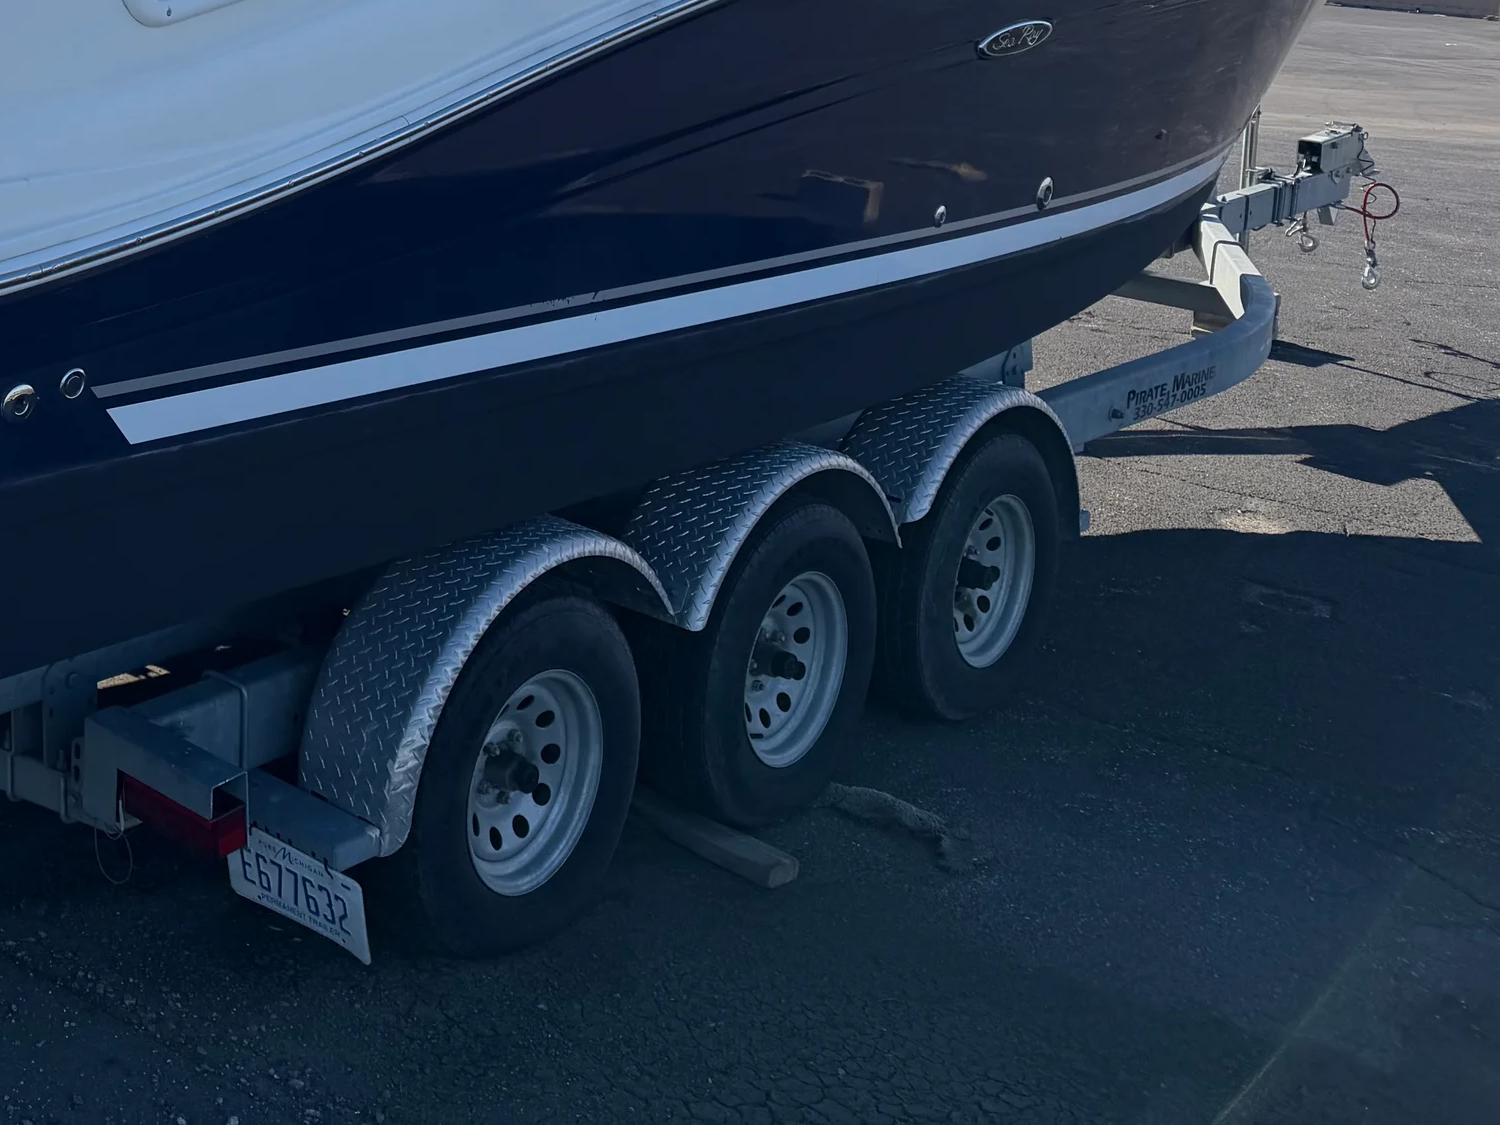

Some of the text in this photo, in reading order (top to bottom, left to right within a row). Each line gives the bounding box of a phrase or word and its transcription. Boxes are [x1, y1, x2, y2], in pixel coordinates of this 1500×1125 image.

[992, 24, 1044, 51] Sea Ray
[1172, 366, 1217, 393] MARINE
[240, 849, 352, 937] E677632
